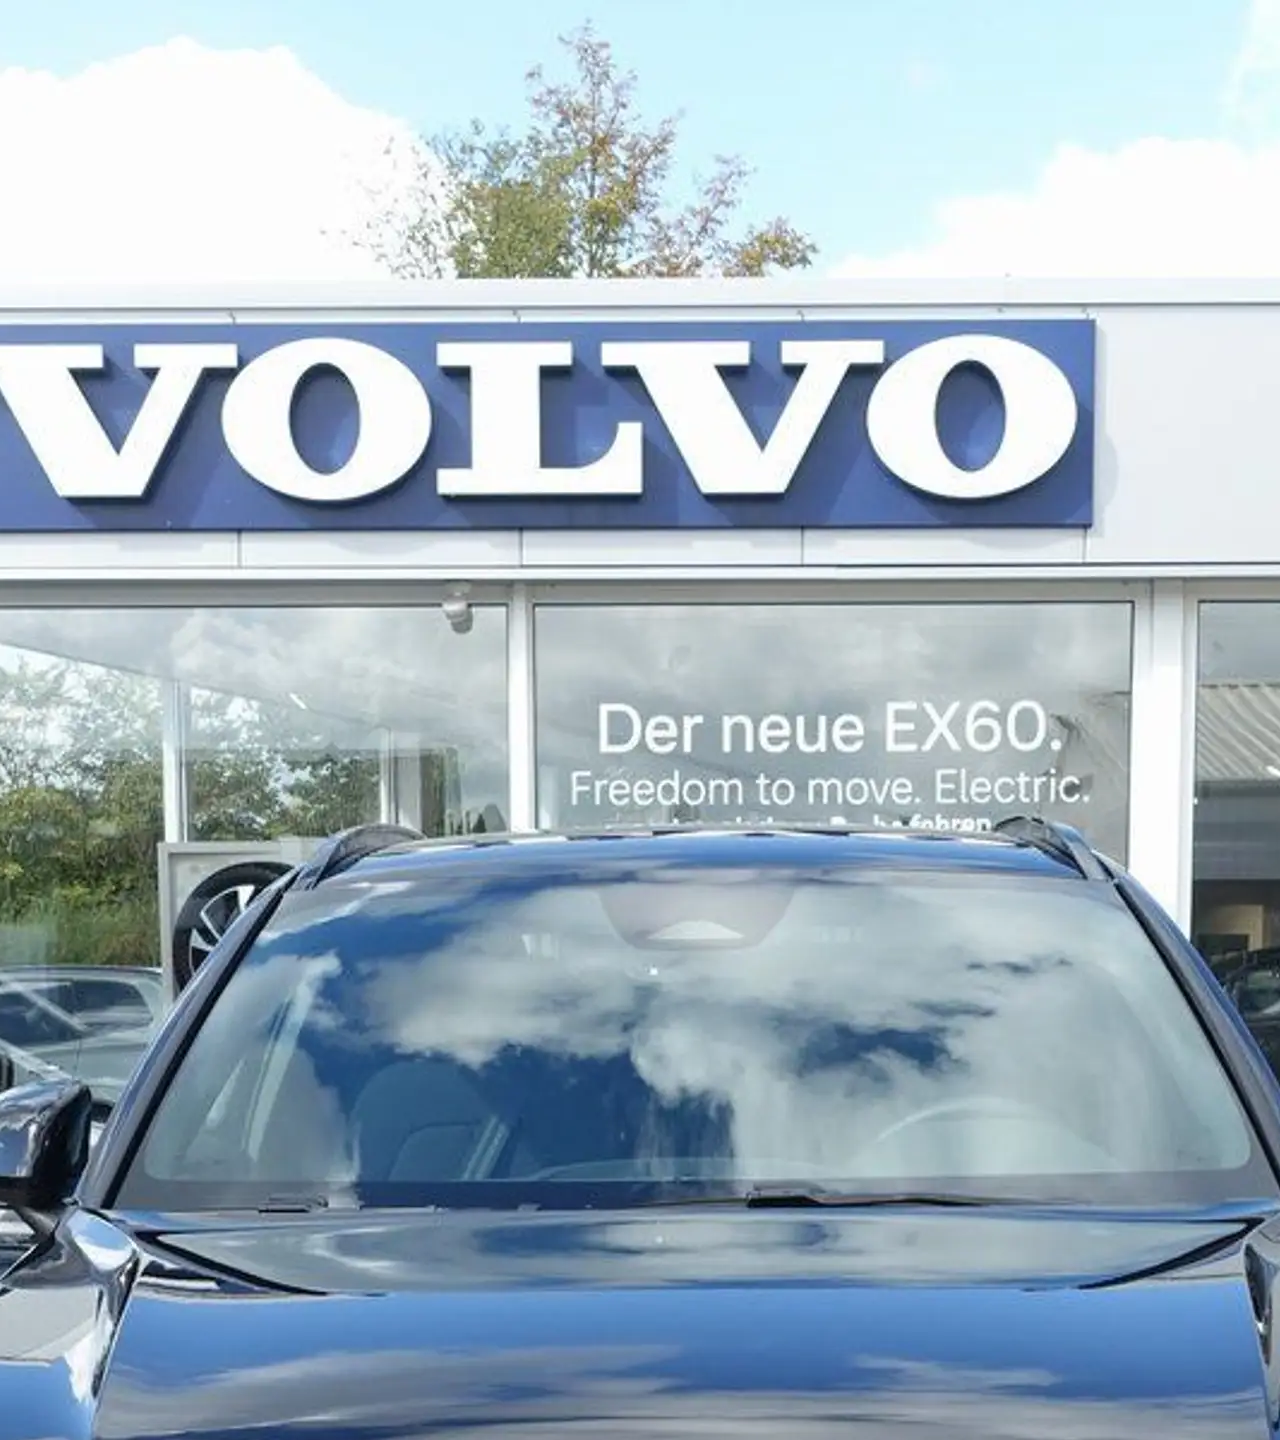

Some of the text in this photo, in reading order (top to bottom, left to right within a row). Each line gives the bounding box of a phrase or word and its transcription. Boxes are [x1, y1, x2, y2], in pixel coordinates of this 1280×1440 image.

[598, 700, 1063, 754] Der neue EX60.
[571, 767, 1091, 807] Freedom to move. Electric.
